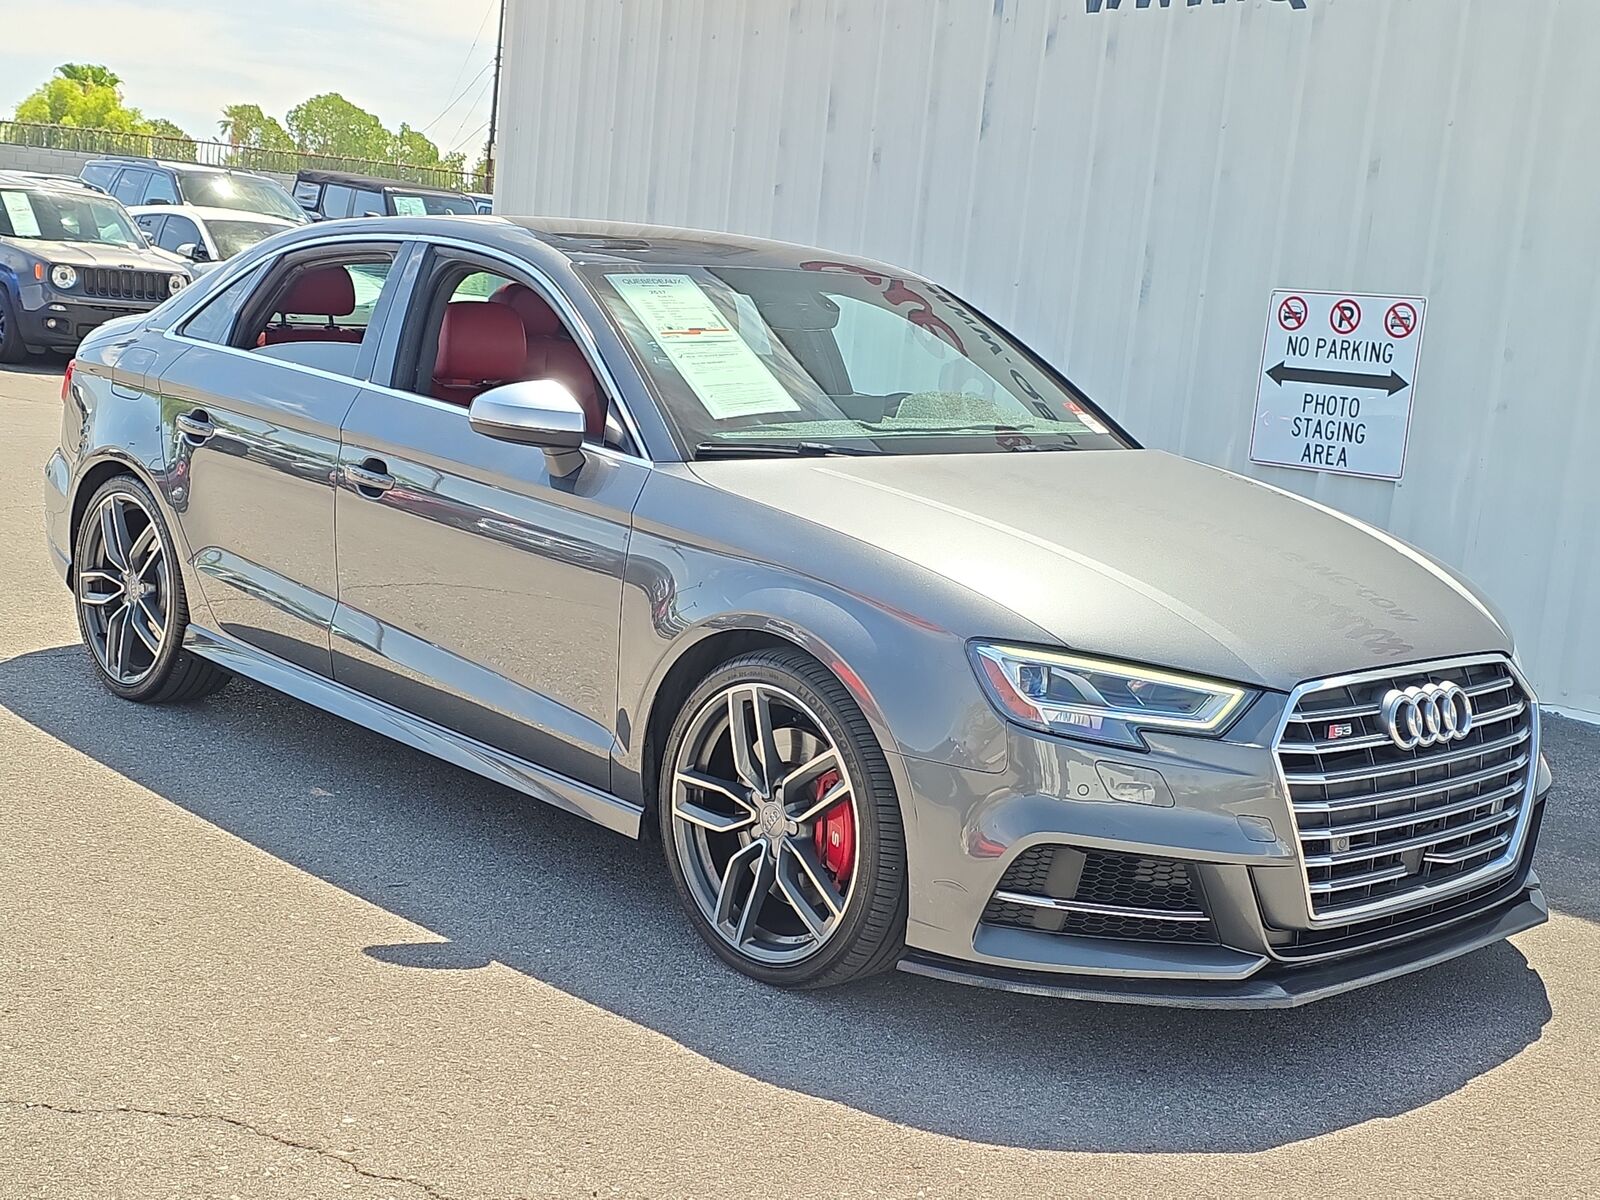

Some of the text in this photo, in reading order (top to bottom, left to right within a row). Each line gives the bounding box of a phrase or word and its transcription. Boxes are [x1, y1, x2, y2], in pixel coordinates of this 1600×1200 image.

[1286, 336, 1394, 364] NO PARKING
[1302, 393, 1360, 418] PHOTO
[1291, 417, 1366, 444] STAGING
[1300, 443, 1348, 467] AREA
[796, 685, 827, 716] LION
[1333, 725, 1352, 737] S3
